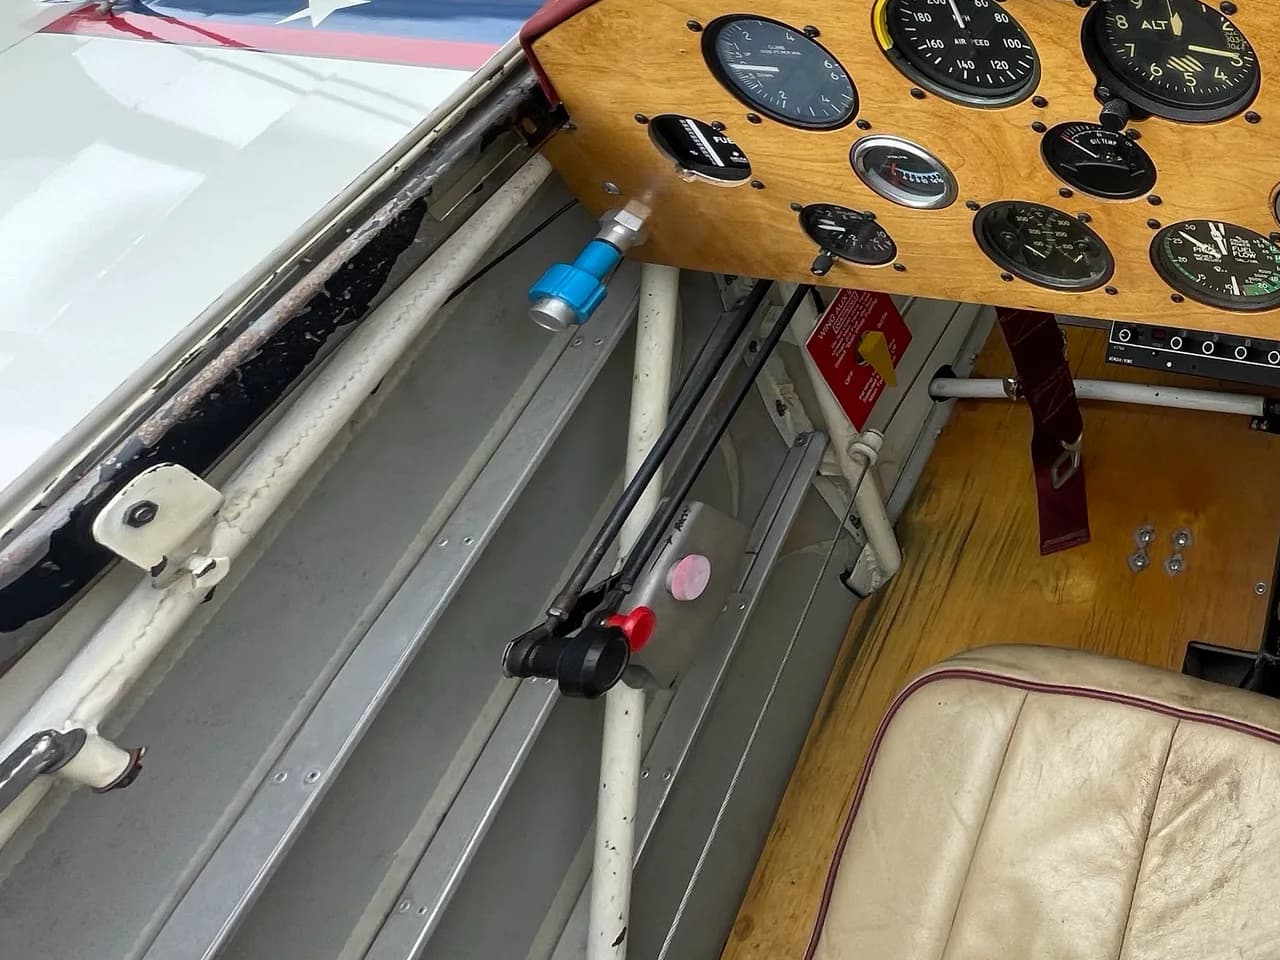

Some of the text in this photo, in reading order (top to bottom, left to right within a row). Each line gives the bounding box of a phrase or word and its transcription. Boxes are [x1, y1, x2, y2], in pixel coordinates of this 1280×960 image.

[913, 12, 1009, 23] 180 MH 80
[1114, 14, 1129, 29] 8
[1141, 20, 1168, 30] ALT
[742, 32, 795, 42] 2 4
[926, 38, 945, 49] 160
[1002, 38, 1022, 49] 100
[1124, 43, 1136, 57] 7
[824, 60, 833, 68] 6
[956, 59, 1009, 70] 140 120
[830, 72, 839, 80] 6
[1150, 62, 1228, 87] 6 5 4
[778, 90, 788, 99] 2
[818, 314, 835, 340] WING
